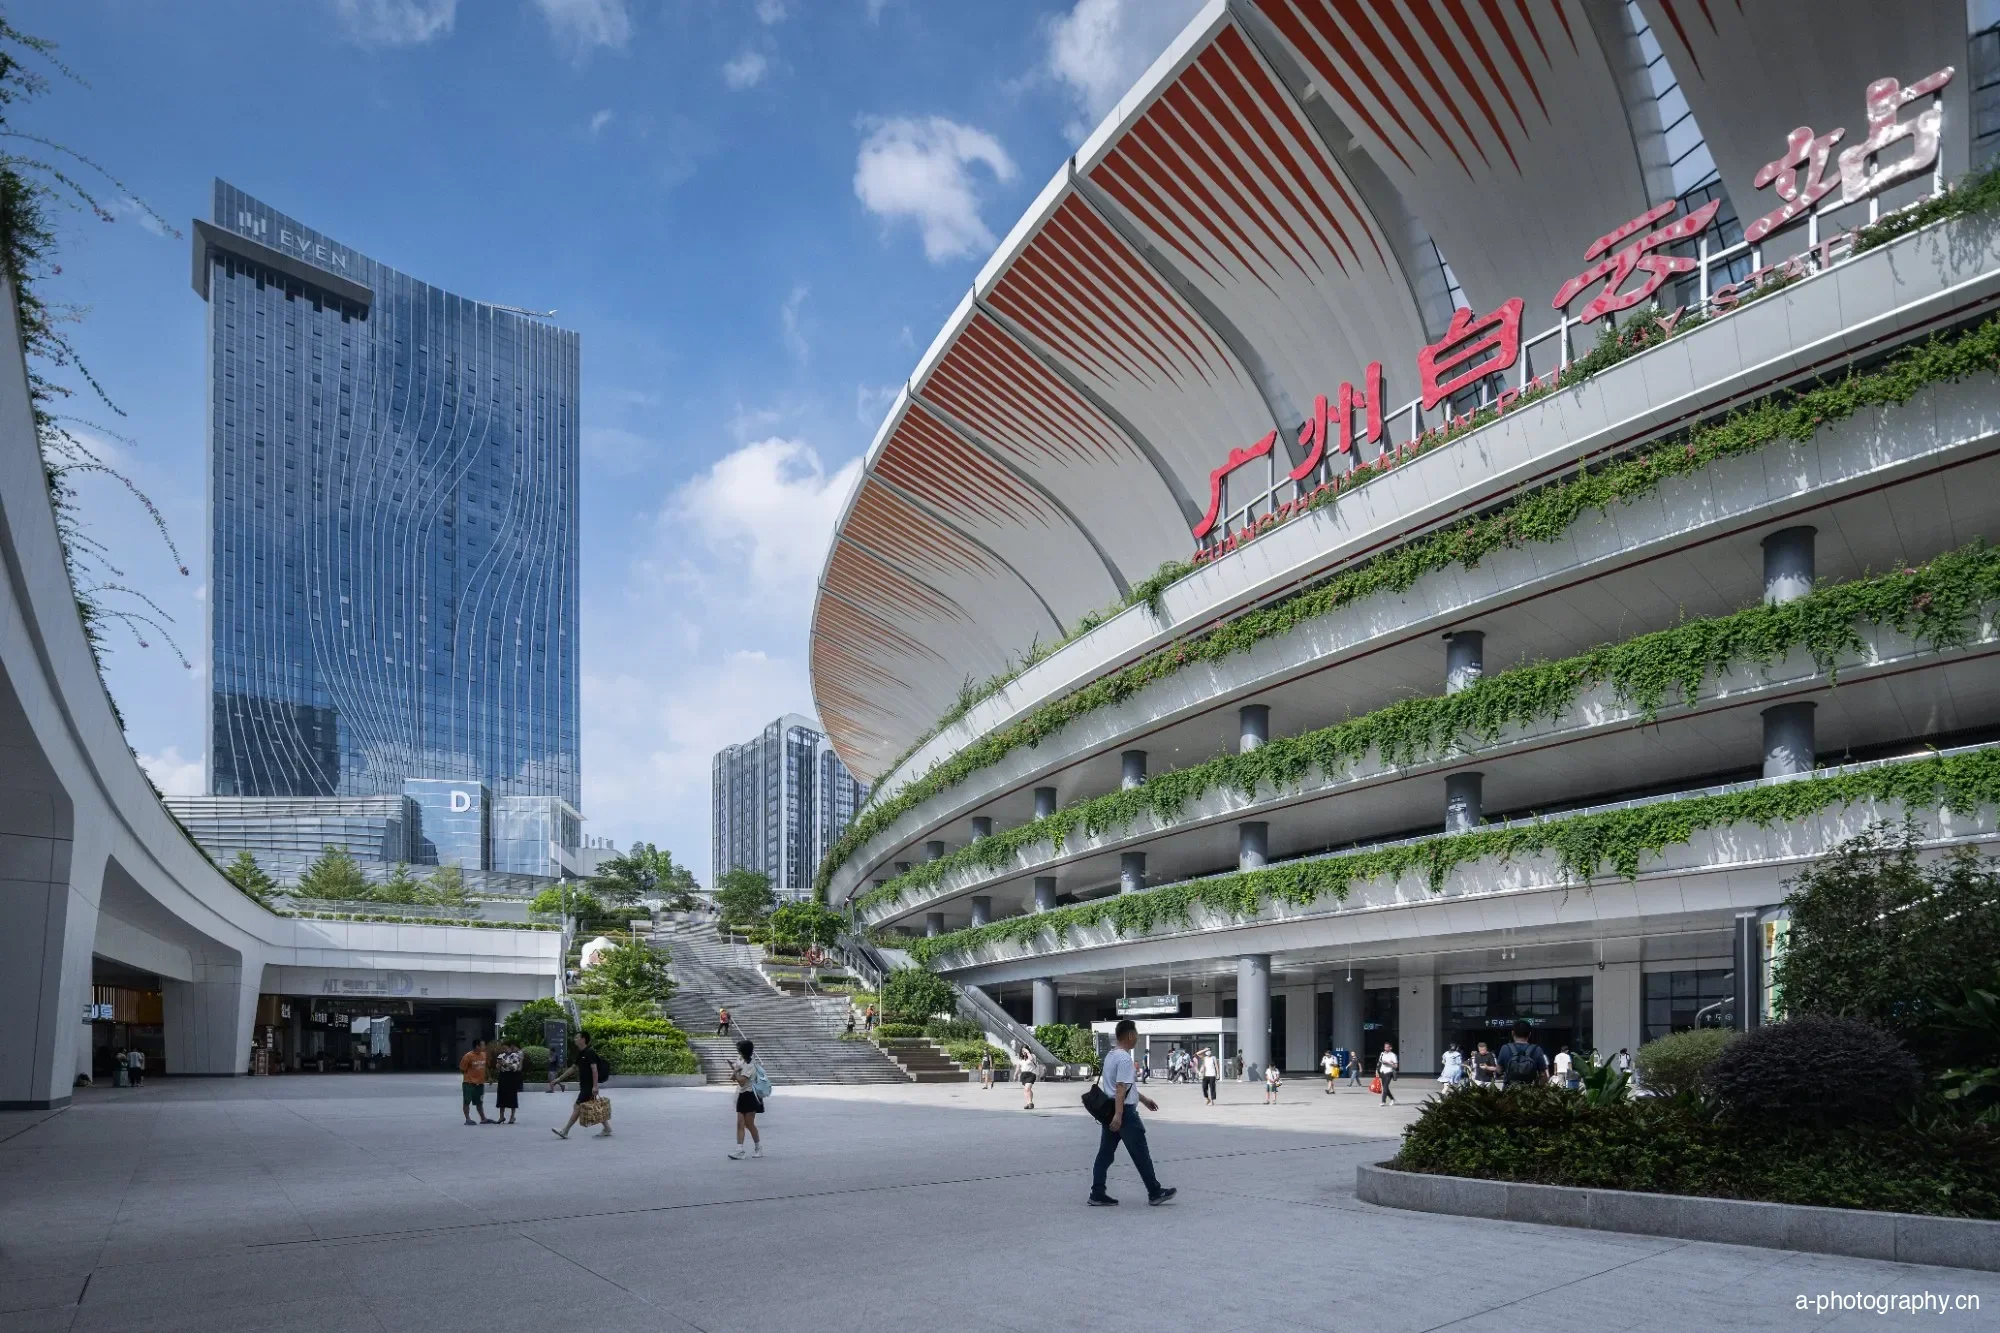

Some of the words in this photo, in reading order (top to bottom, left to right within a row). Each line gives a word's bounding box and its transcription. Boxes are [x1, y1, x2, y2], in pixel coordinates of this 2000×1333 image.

[280, 229, 347, 269] EVEN
[1192, 66, 1955, 539] 广州白云站
[450, 790, 472, 812] D
